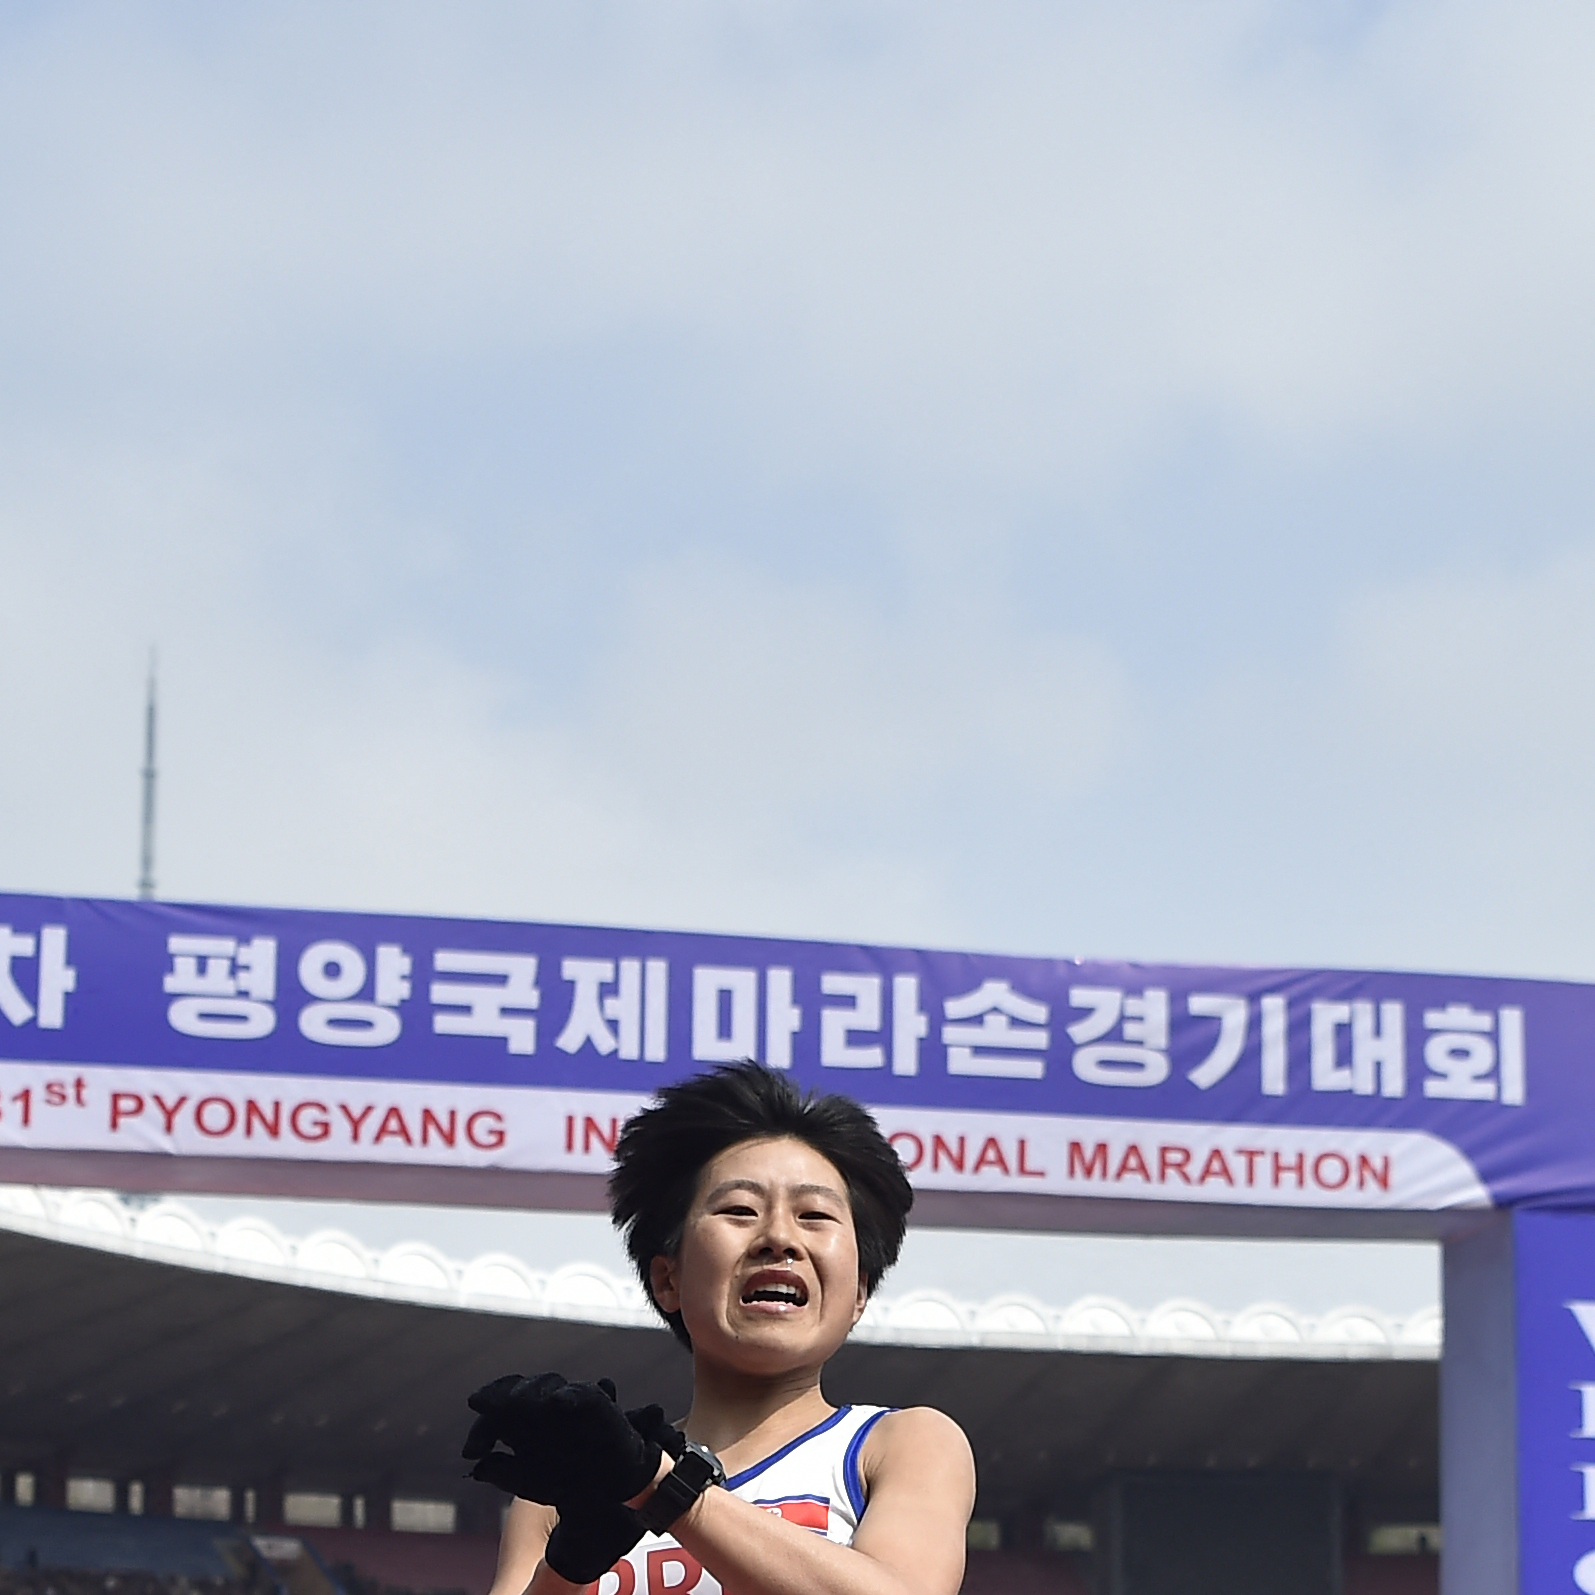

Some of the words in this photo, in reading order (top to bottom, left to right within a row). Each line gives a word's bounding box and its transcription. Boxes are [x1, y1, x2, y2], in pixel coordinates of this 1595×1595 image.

[162, 934, 1526, 1106] 평양국제마라손경기대회
[107, 1091, 507, 1151] PYONGYANG
[1067, 1140, 1391, 1192] MARATHON
